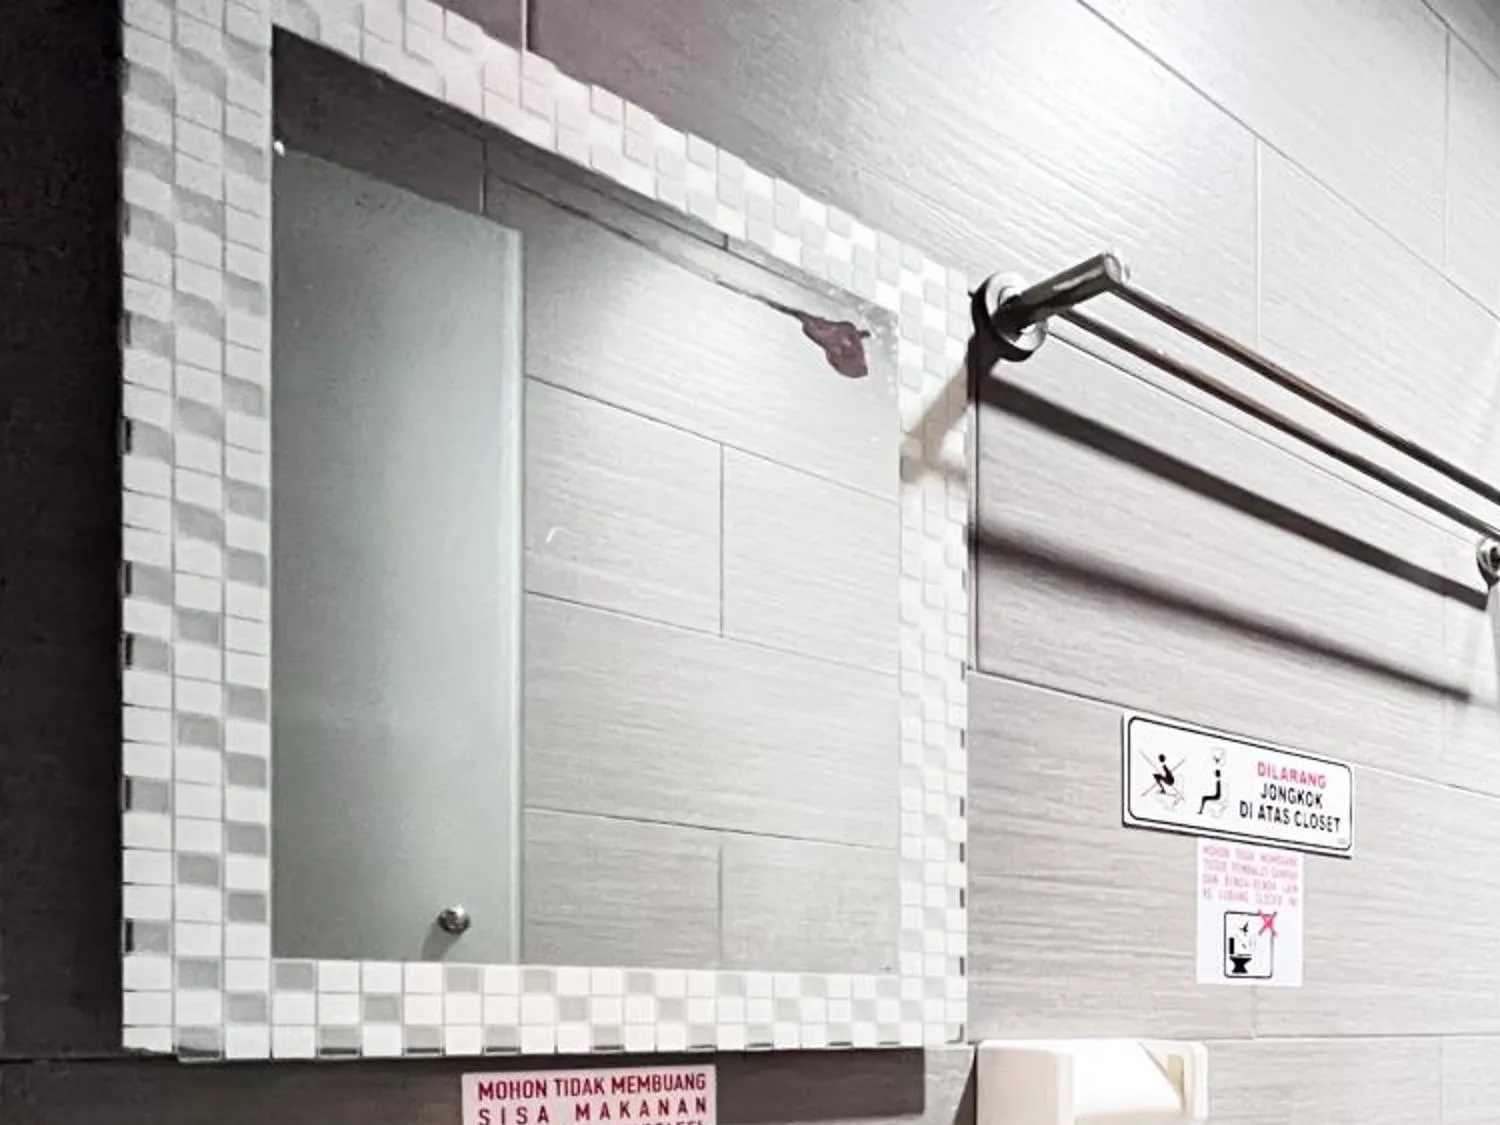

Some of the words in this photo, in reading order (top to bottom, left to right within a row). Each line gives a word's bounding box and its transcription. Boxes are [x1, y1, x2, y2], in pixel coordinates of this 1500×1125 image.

[1257, 760, 1326, 789] DILARANG
[1260, 782, 1323, 809] JONGKOK
[1240, 800, 1252, 819] DI
[1258, 804, 1290, 825] ATAS
[1294, 810, 1340, 832] CLOSET
[478, 1079, 547, 1101] MOHON
[553, 1077, 605, 1097] TIDAK
[611, 1073, 706, 1095] MEMBUANG
[575, 1097, 707, 1121] MAKANAN
